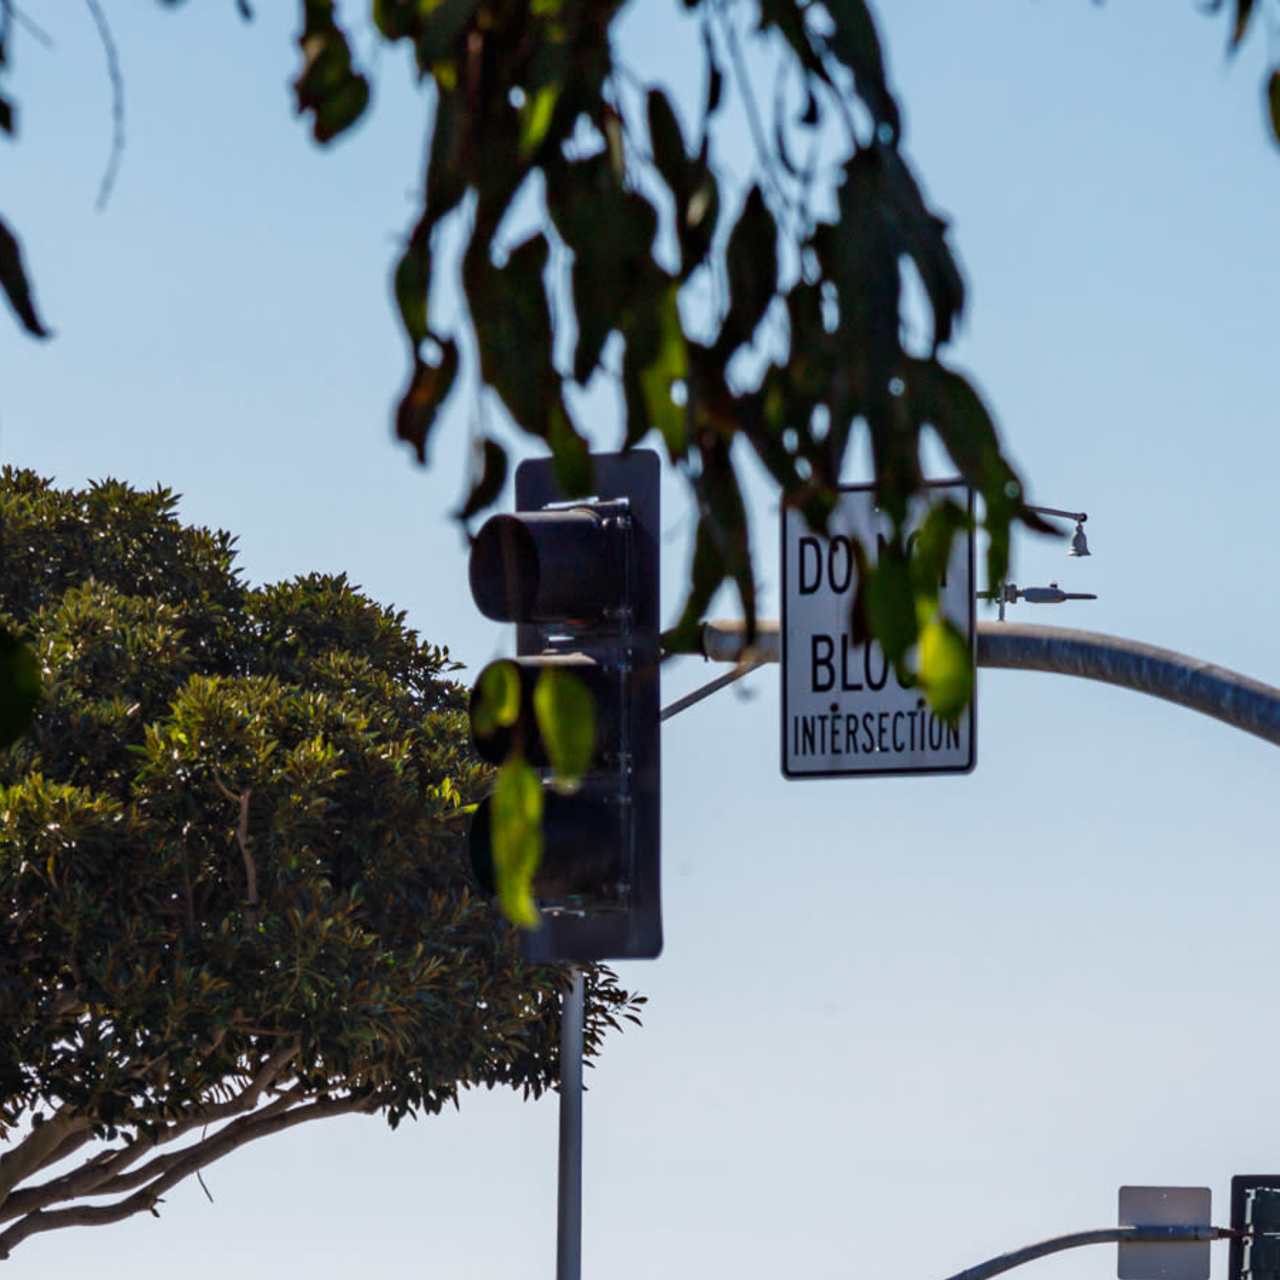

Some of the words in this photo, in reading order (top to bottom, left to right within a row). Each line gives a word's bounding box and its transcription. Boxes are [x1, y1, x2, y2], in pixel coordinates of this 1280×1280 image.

[798, 534, 854, 595] DO
[811, 630, 918, 693] BLO
[793, 710, 961, 756] INTERSECTION
